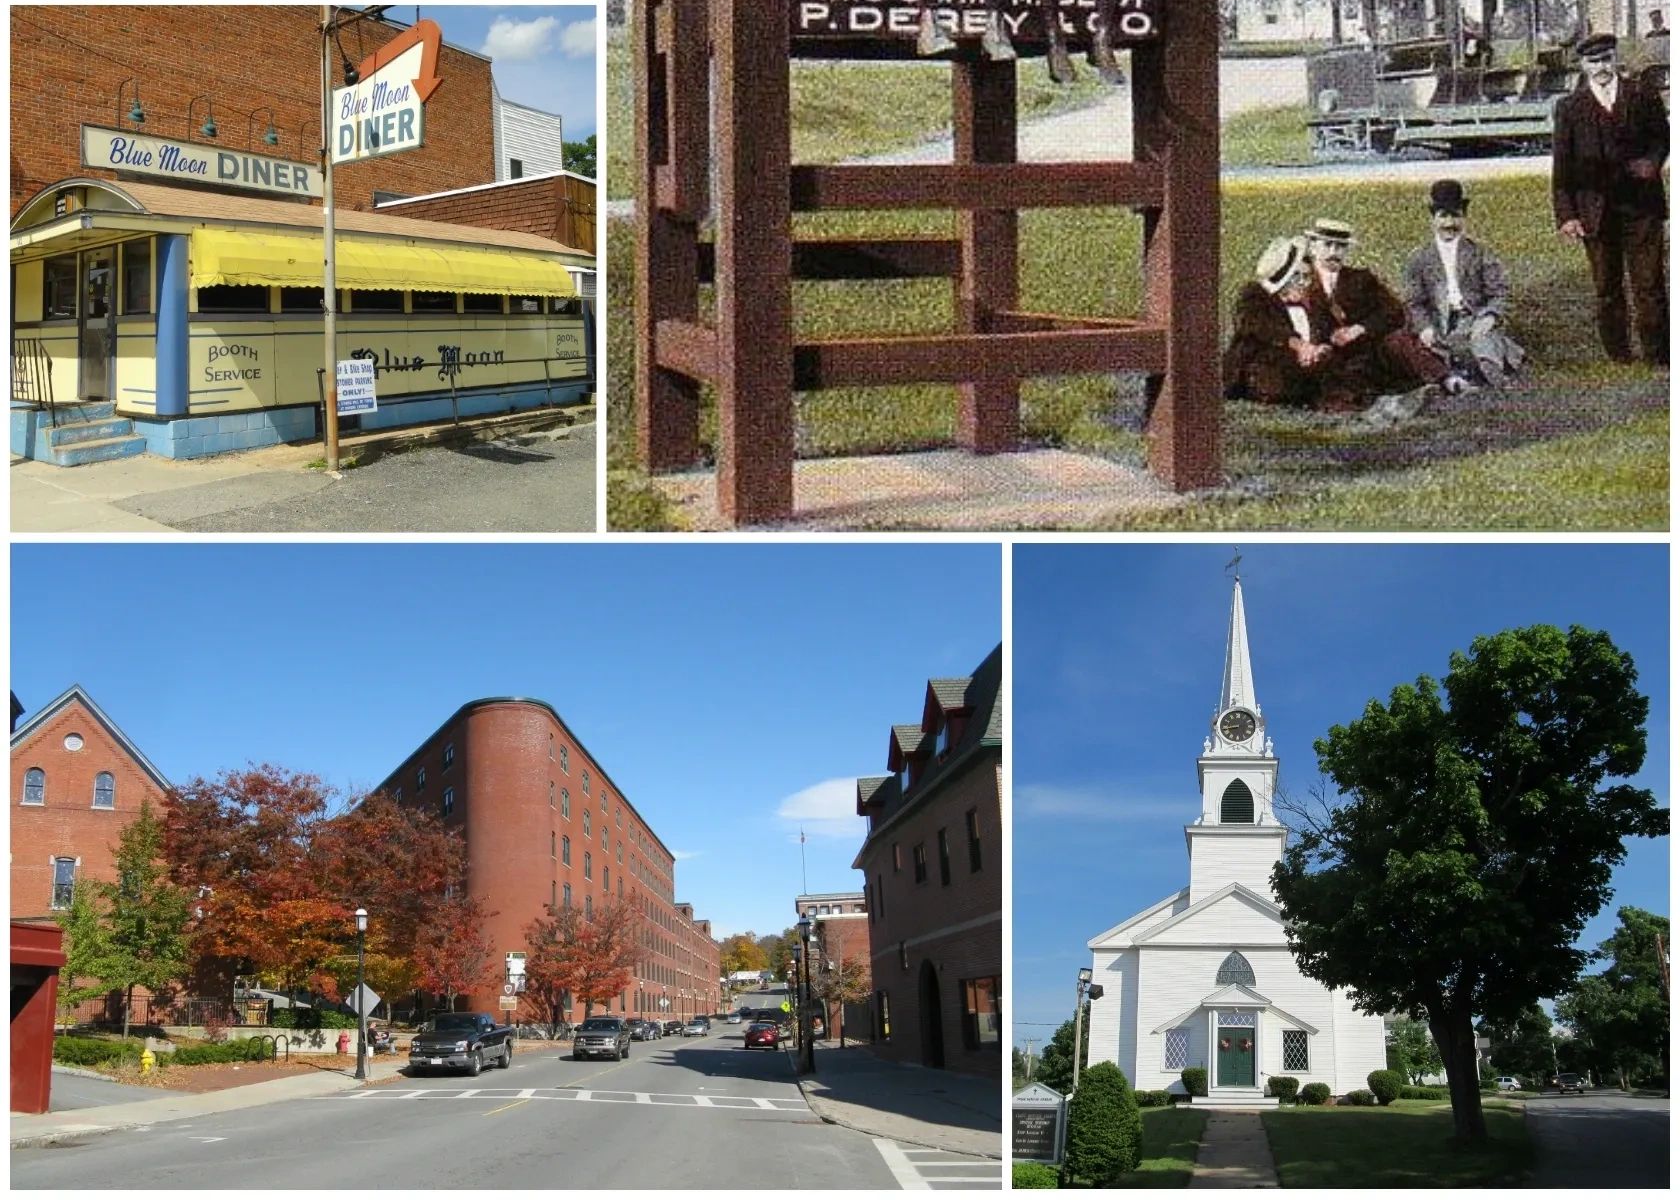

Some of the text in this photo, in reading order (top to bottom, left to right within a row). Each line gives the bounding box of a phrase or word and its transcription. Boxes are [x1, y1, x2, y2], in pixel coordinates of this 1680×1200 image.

[800, 2, 838, 30] P.
[340, 80, 410, 120] Blue Moon
[339, 107, 416, 156] DINER
[109, 136, 310, 191] Blue Moon DINER
[208, 344, 259, 363] BOOTH
[205, 366, 262, 382] SERVICE
